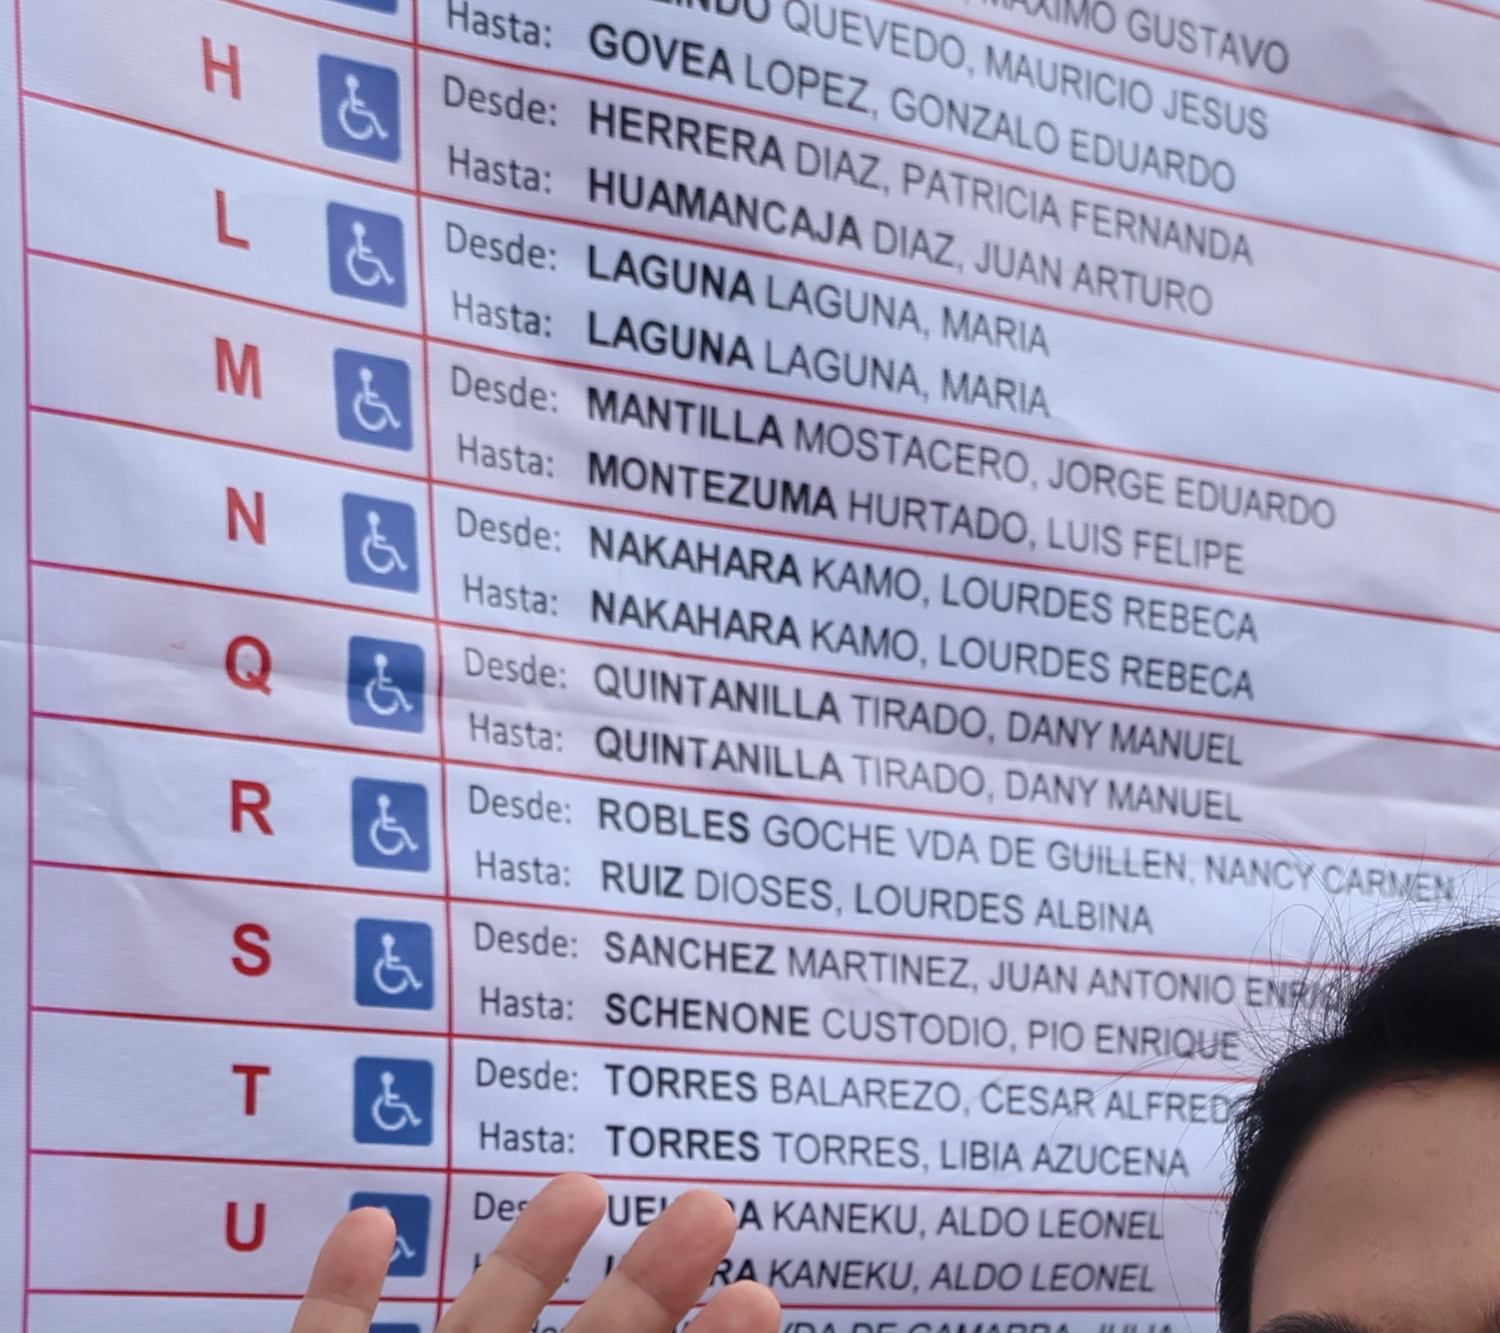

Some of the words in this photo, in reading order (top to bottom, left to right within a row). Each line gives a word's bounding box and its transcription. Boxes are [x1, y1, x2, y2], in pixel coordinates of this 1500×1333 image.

[204, 39, 239, 98] H
[782, 0, 974, 76] QUEVEDO,
[985, 43, 1153, 114] MAURICIO
[1162, 89, 1268, 140] JESUS
[1125, 6, 1290, 75] GUSTAVO
[446, 0, 551, 48] Hasta:
[589, 22, 734, 84] GOVEA
[745, 53, 877, 120] LOPEZ,
[890, 86, 1060, 155] GONZALO
[1069, 127, 1236, 193] EDUARDO
[443, 74, 557, 127] Desde:
[590, 99, 785, 171] HERRERA
[795, 140, 889, 196] DIAZ,
[902, 160, 1061, 228] PATRICIA
[1070, 198, 1253, 266] FERNANDA
[217, 191, 248, 247] L
[448, 144, 551, 194] Hasta:
[589, 167, 862, 250] HUAMANCAJA
[873, 219, 963, 274] DIAZ,
[974, 241, 1062, 290] JUAN
[1071, 260, 1213, 316] ARTURO
[445, 221, 556, 271] Desde:
[588, 244, 755, 305] LAGUNA
[766, 274, 929, 339] LAGUNA,
[941, 304, 1049, 357] MARIA
[217, 338, 260, 397] M
[452, 290, 551, 338] Hasta:
[588, 311, 754, 370] LAGUNA
[765, 339, 929, 403] LAGUNA,
[941, 367, 1051, 419] MARIA
[451, 363, 557, 413] Desde:
[586, 385, 784, 448] MANTILLA
[795, 417, 1036, 488] MOSTACERO,
[1047, 457, 1165, 505] JORGE
[1175, 475, 1336, 529] EDUARDO
[228, 488, 264, 544] N
[457, 433, 553, 478] Hasta:
[588, 451, 837, 520] MONTEZUMA
[848, 489, 1036, 552] HURTADO,
[1047, 517, 1123, 558] LUIS
[1133, 528, 1245, 575] FELIPE
[455, 505, 560, 552] Desde:
[590, 526, 802, 587] NAKAHARA
[812, 556, 929, 607] KAMO,
[942, 573, 1112, 625] LOURDES
[1123, 595, 1258, 643] REBECA
[226, 636, 271, 693] Q
[462, 573, 558, 617] Hasta:
[591, 589, 801, 648] NAKAHARA
[811, 619, 927, 668] KAMO,
[940, 634, 1110, 684] LOURDES
[1121, 654, 1254, 701] REBECA
[464, 646, 566, 690] Desde:
[594, 663, 841, 724] QUINTANILLA
[850, 693, 995, 745] TIRADO,
[1007, 710, 1103, 750] DANY
[1110, 721, 1243, 766] MANUEL
[232, 780, 272, 834] R
[468, 711, 562, 752] Hasta:
[595, 725, 844, 783] QUINTANILLA
[851, 753, 994, 804] TIRADO,
[1006, 769, 1098, 808] DANY
[1108, 780, 1243, 823] MANUEL
[468, 783, 571, 824] Desde:
[598, 797, 750, 844] ROBLES
[762, 814, 896, 857] GOCHE
[906, 827, 980, 864] VDA
[989, 834, 1036, 869] DE
[1046, 839, 1195, 884] GUILLEN,
[1203, 850, 1317, 891] NANCY
[1322, 863, 1456, 904] CARMEN
[475, 849, 570, 887] Hasta:
[602, 859, 685, 899] RUIZ
[696, 868, 842, 917] DIOSES,
[855, 882, 1025, 926] LOURDES
[1034, 897, 1154, 935] ALBINA
[233, 923, 271, 976] S
[473, 920, 577, 958] Desde:
[605, 931, 777, 975] SANCHEZ
[787, 945, 978, 993] MARTINEZ,
[988, 960, 1078, 995] JUAN
[1087, 966, 1236, 1005] ANTONIO
[479, 985, 573, 1021] Hasta:
[605, 992, 810, 1037] SCHENONE
[822, 1007, 1016, 1053] CUSTODIO,
[1027, 1018, 1085, 1052] PIO
[1094, 1022, 1239, 1061] ENRIQUE
[233, 1065, 270, 1114] T
[476, 1057, 578, 1091] Desde:
[604, 1063, 758, 1102] TORRES
[770, 1072, 969, 1117] BALAREZO,
[980, 1080, 1096, 1118] CESAR
[480, 1121, 574, 1154] Hasta:
[605, 1125, 760, 1162] TORRES
[771, 1131, 929, 1173] TORRES,
[940, 1139, 1023, 1172] LIBIA
[1031, 1142, 1189, 1179] AZUCENA
[226, 1202, 265, 1251] U
[773, 1200, 925, 1239] KANEKU,
[936, 1205, 1029, 1238] ALDO
[1039, 1208, 1164, 1240] LEONEL
[766, 1258, 919, 1294] KANEKU,
[929, 1262, 1023, 1291] ALDO
[1030, 1262, 1156, 1293] LEONEL
